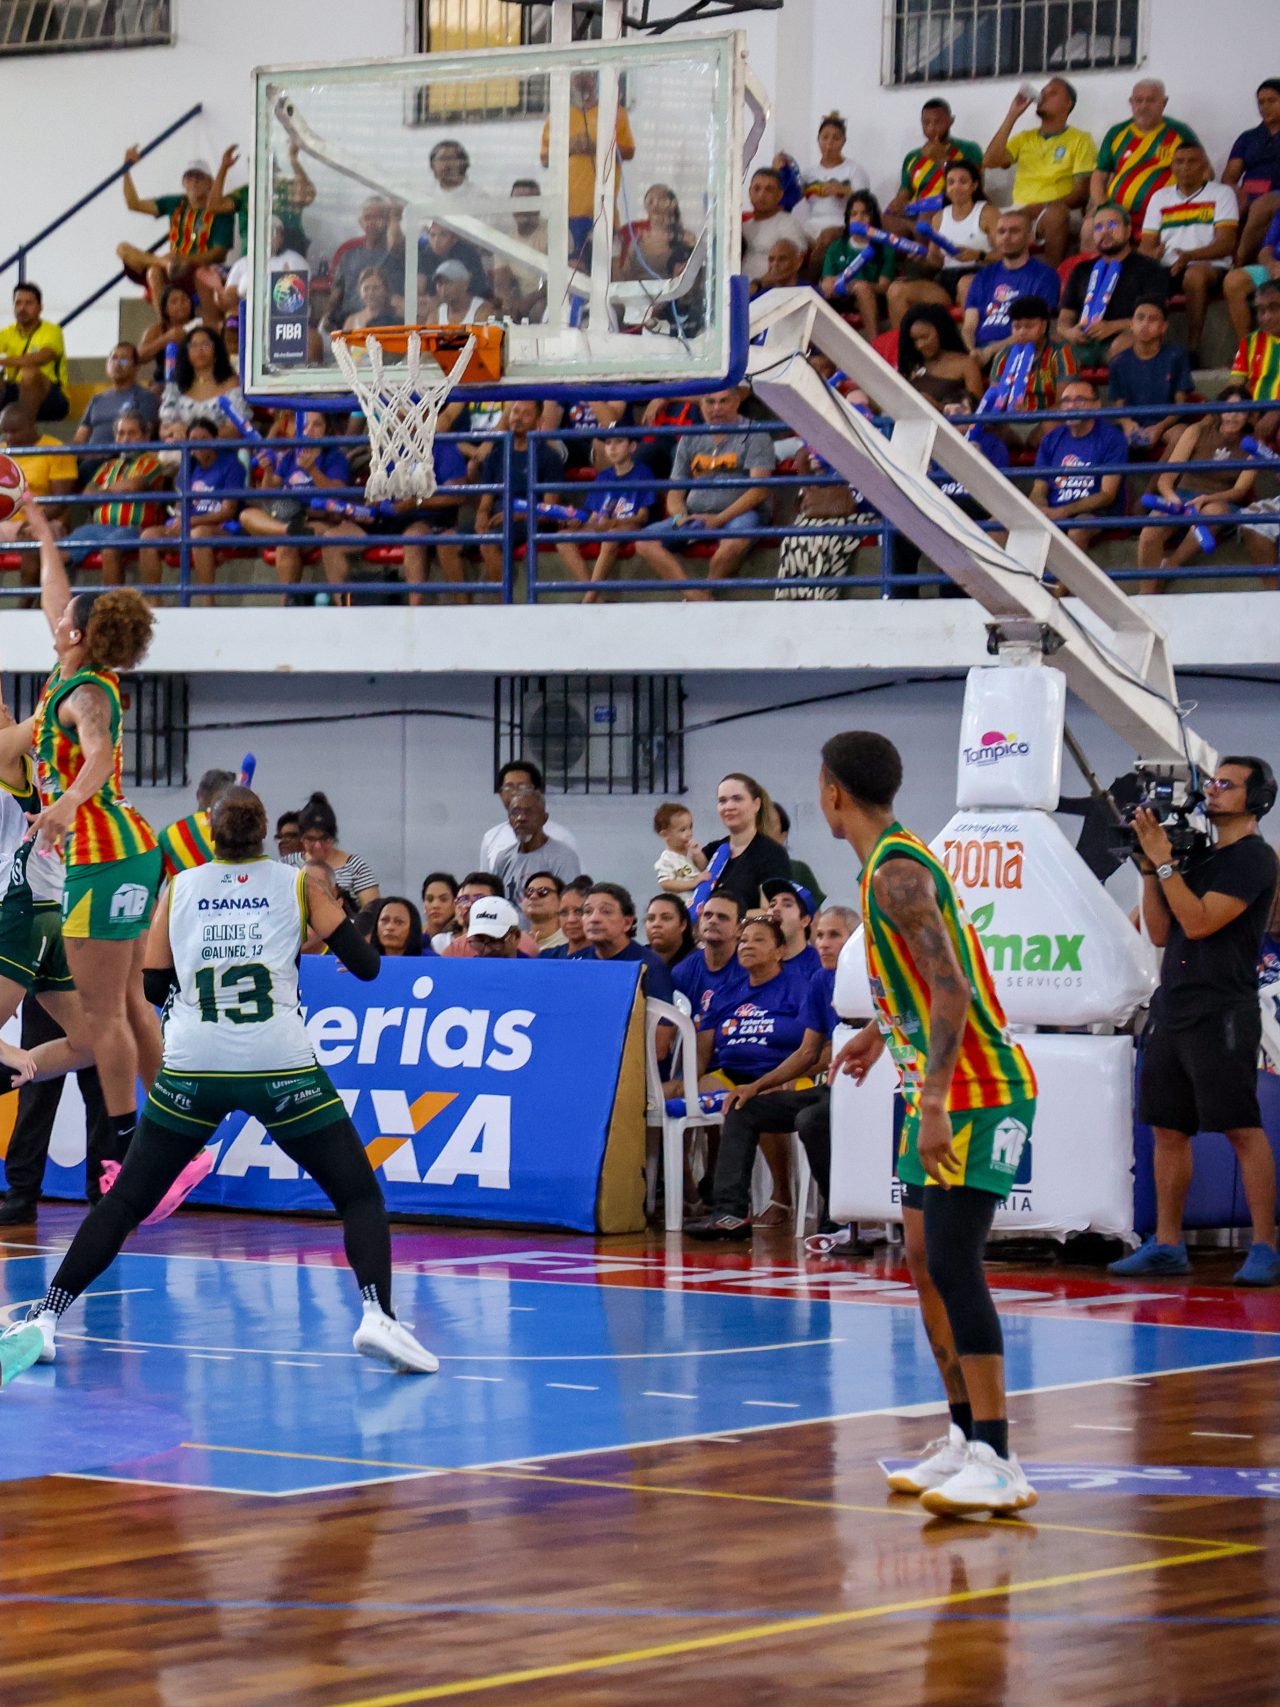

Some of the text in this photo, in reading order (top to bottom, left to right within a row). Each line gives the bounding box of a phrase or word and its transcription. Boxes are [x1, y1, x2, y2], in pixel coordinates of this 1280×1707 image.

[276, 322, 302, 341] FIBA
[963, 741, 1030, 765] Tampico
[954, 821, 1020, 839] cervejaria
[212, 897, 270, 911] SANASA
[203, 922, 262, 942] ALINE C.
[201, 944, 263, 961] @ALINEC_13
[1006, 976, 1083, 990] SERVIÇOS
[195, 962, 274, 1025] 13
[301, 976, 537, 1072] erias
[739, 1024, 774, 1035] CAIXA
